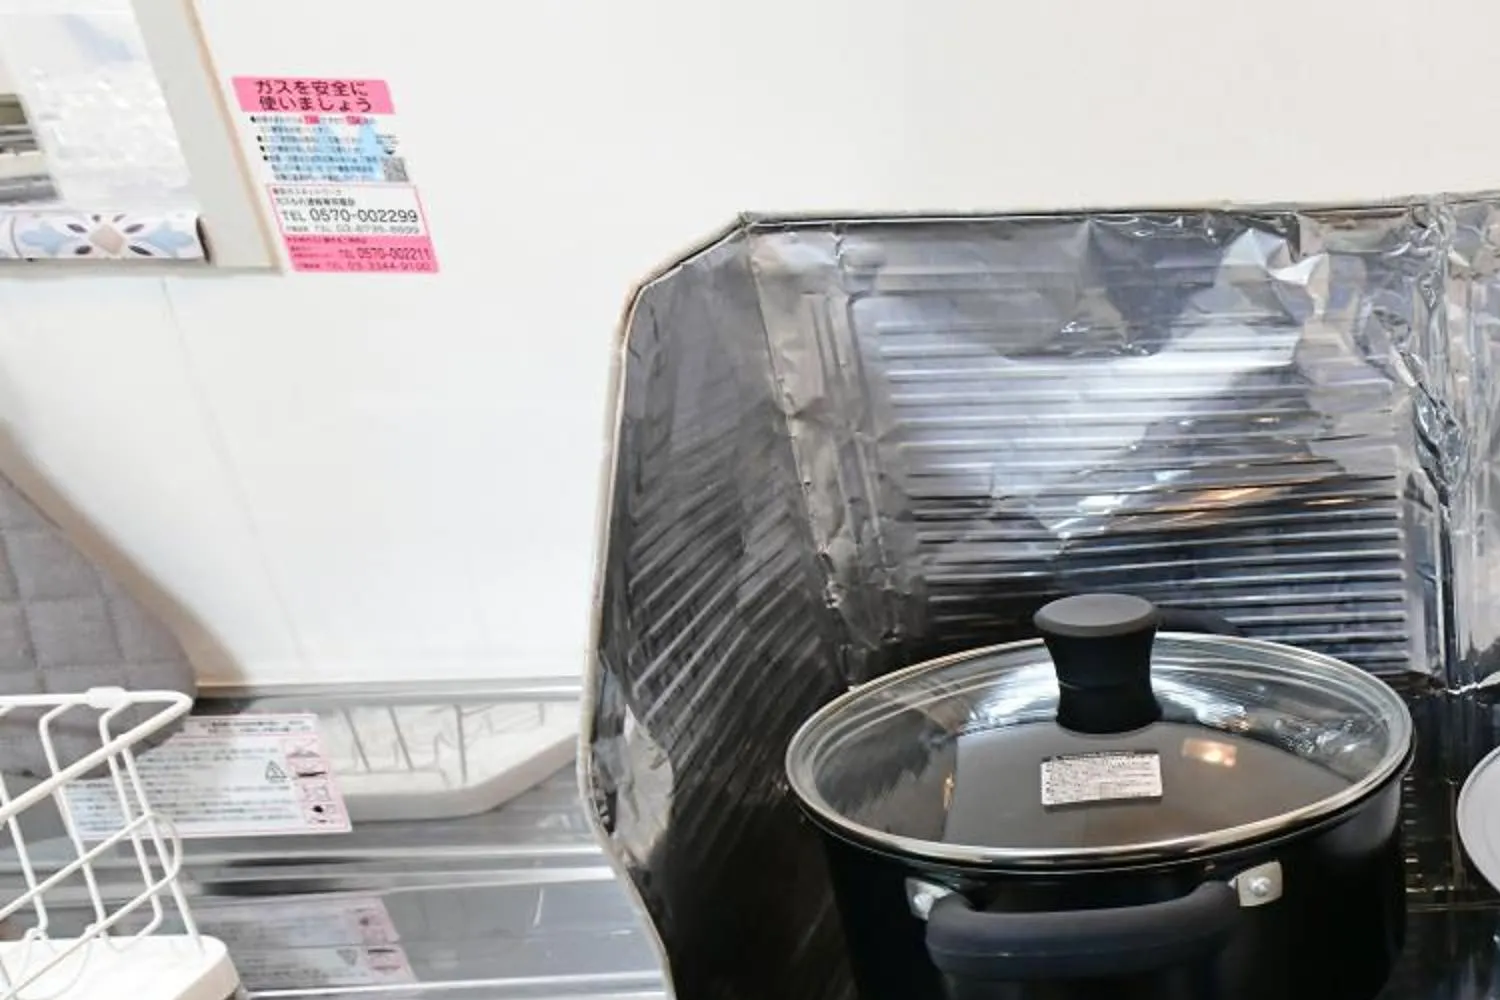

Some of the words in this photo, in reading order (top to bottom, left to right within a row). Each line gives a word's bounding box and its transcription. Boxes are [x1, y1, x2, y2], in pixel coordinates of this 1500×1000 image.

[255, 80, 369, 97] ガスを安全に
[259, 95, 372, 112] 使いましょう
[282, 210, 305, 222] TEL
[308, 207, 419, 223] 0570-002299
